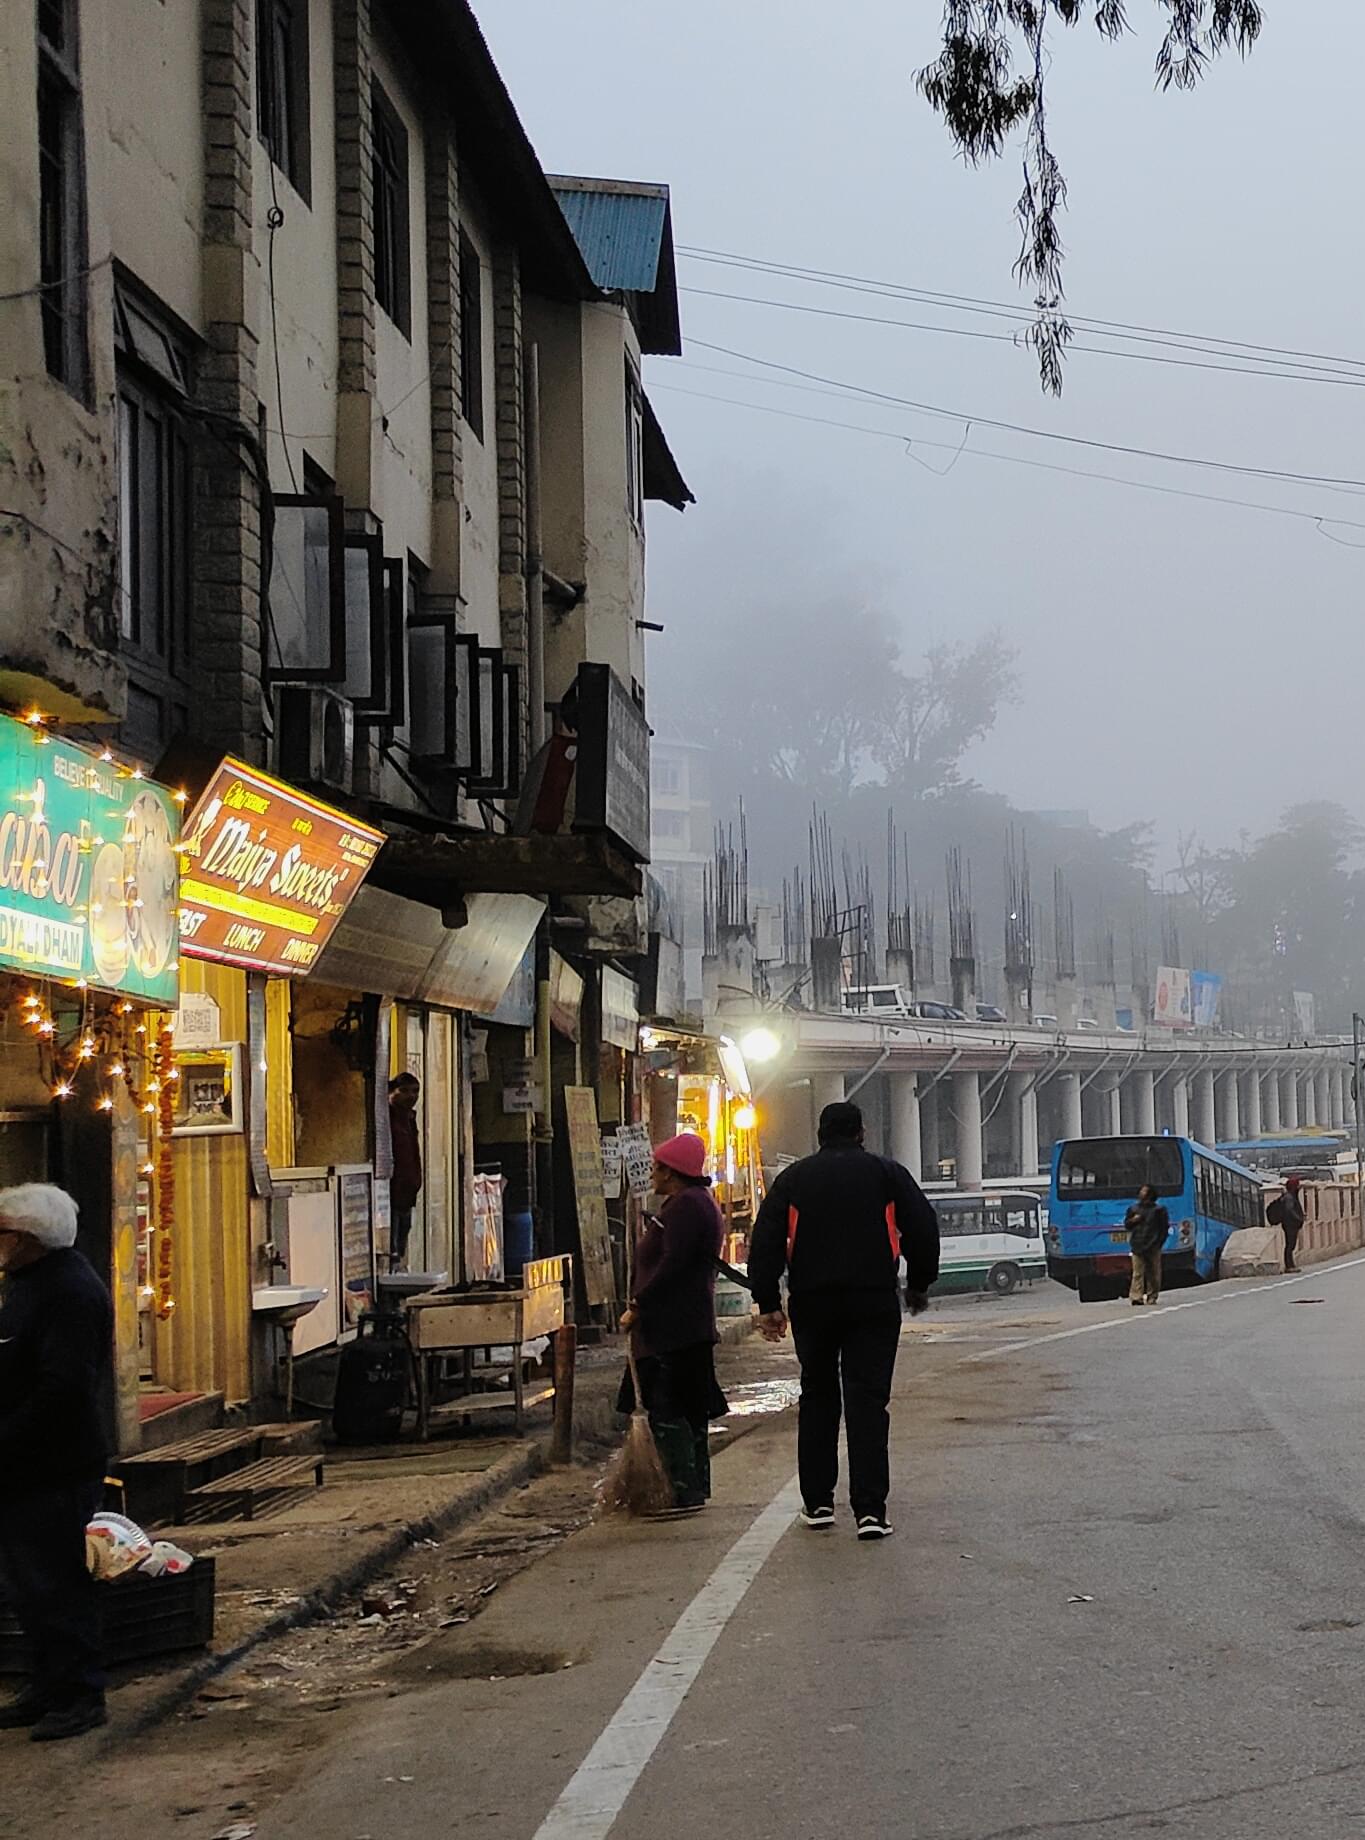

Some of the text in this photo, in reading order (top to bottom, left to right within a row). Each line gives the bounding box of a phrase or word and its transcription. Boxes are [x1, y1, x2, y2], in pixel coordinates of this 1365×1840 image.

[54, 755, 85, 787] BELIEVE
[44, 924, 80, 964] DHAM
[223, 923, 266, 952] LUNCH
[281, 938, 319, 965] DINNER
